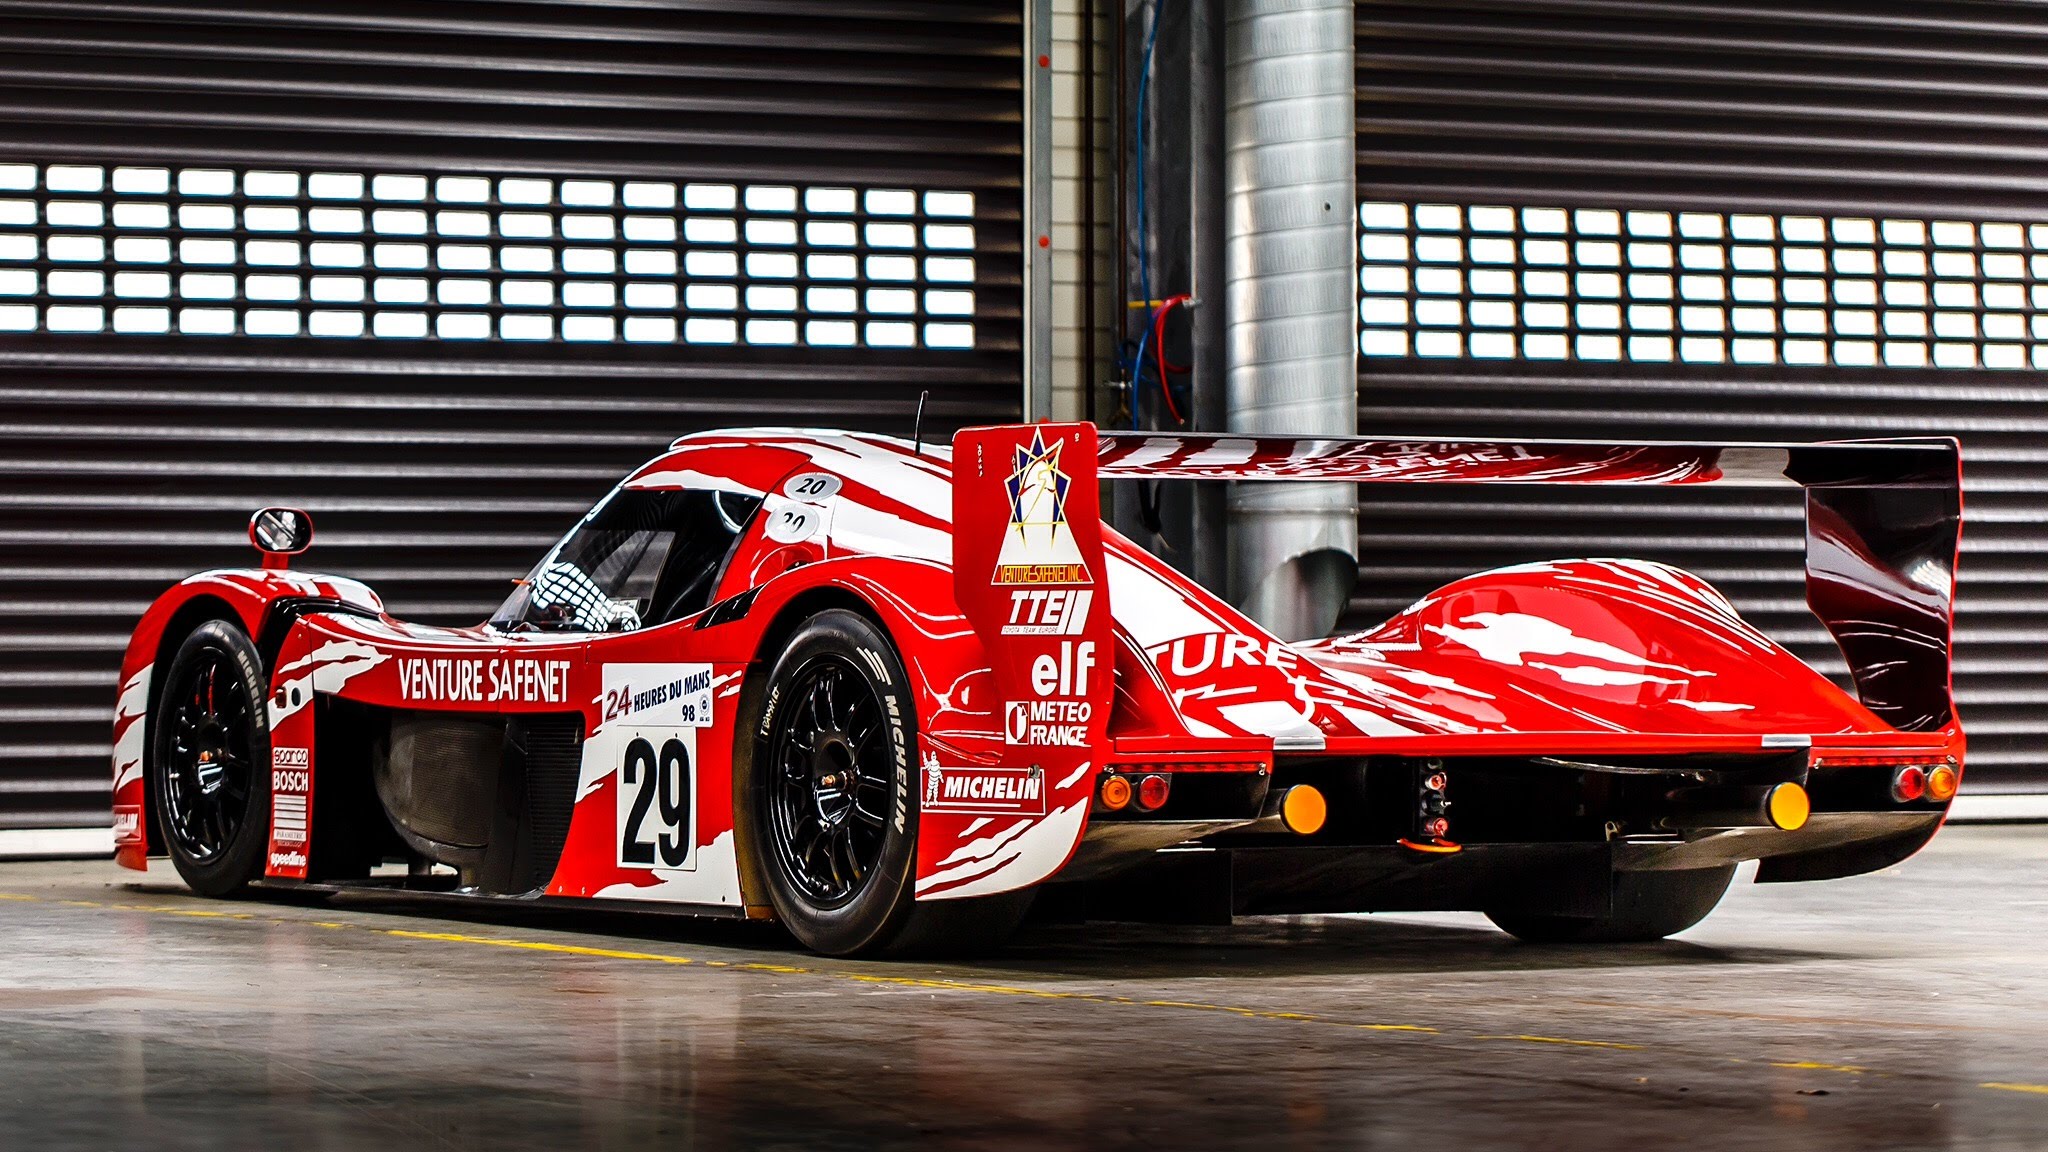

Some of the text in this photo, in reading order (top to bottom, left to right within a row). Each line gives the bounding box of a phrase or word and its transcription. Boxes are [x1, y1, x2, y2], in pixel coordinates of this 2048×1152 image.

[795, 478, 827, 495] 20
[1038, 626, 1059, 634] EUROPE
[1031, 641, 1095, 696] elf
[237, 650, 264, 728] MICHELIN
[398, 658, 571, 703] VENTURE SAFENET
[605, 684, 632, 722] 24
[634, 685, 667, 713] HEURES
[669, 679, 682, 701] DU
[684, 670, 710, 696] MANS
[682, 704, 695, 722] 98
[1030, 701, 1092, 723] METEO
[1030, 725, 1089, 746] FRANCE
[274, 749, 308, 764] sparco
[885, 694, 907, 835] MICHELIN
[272, 771, 309, 791] BOSCH
[944, 776, 1041, 799] MICHELIN
[622, 737, 691, 867] 29
[271, 851, 307, 868] speedline
